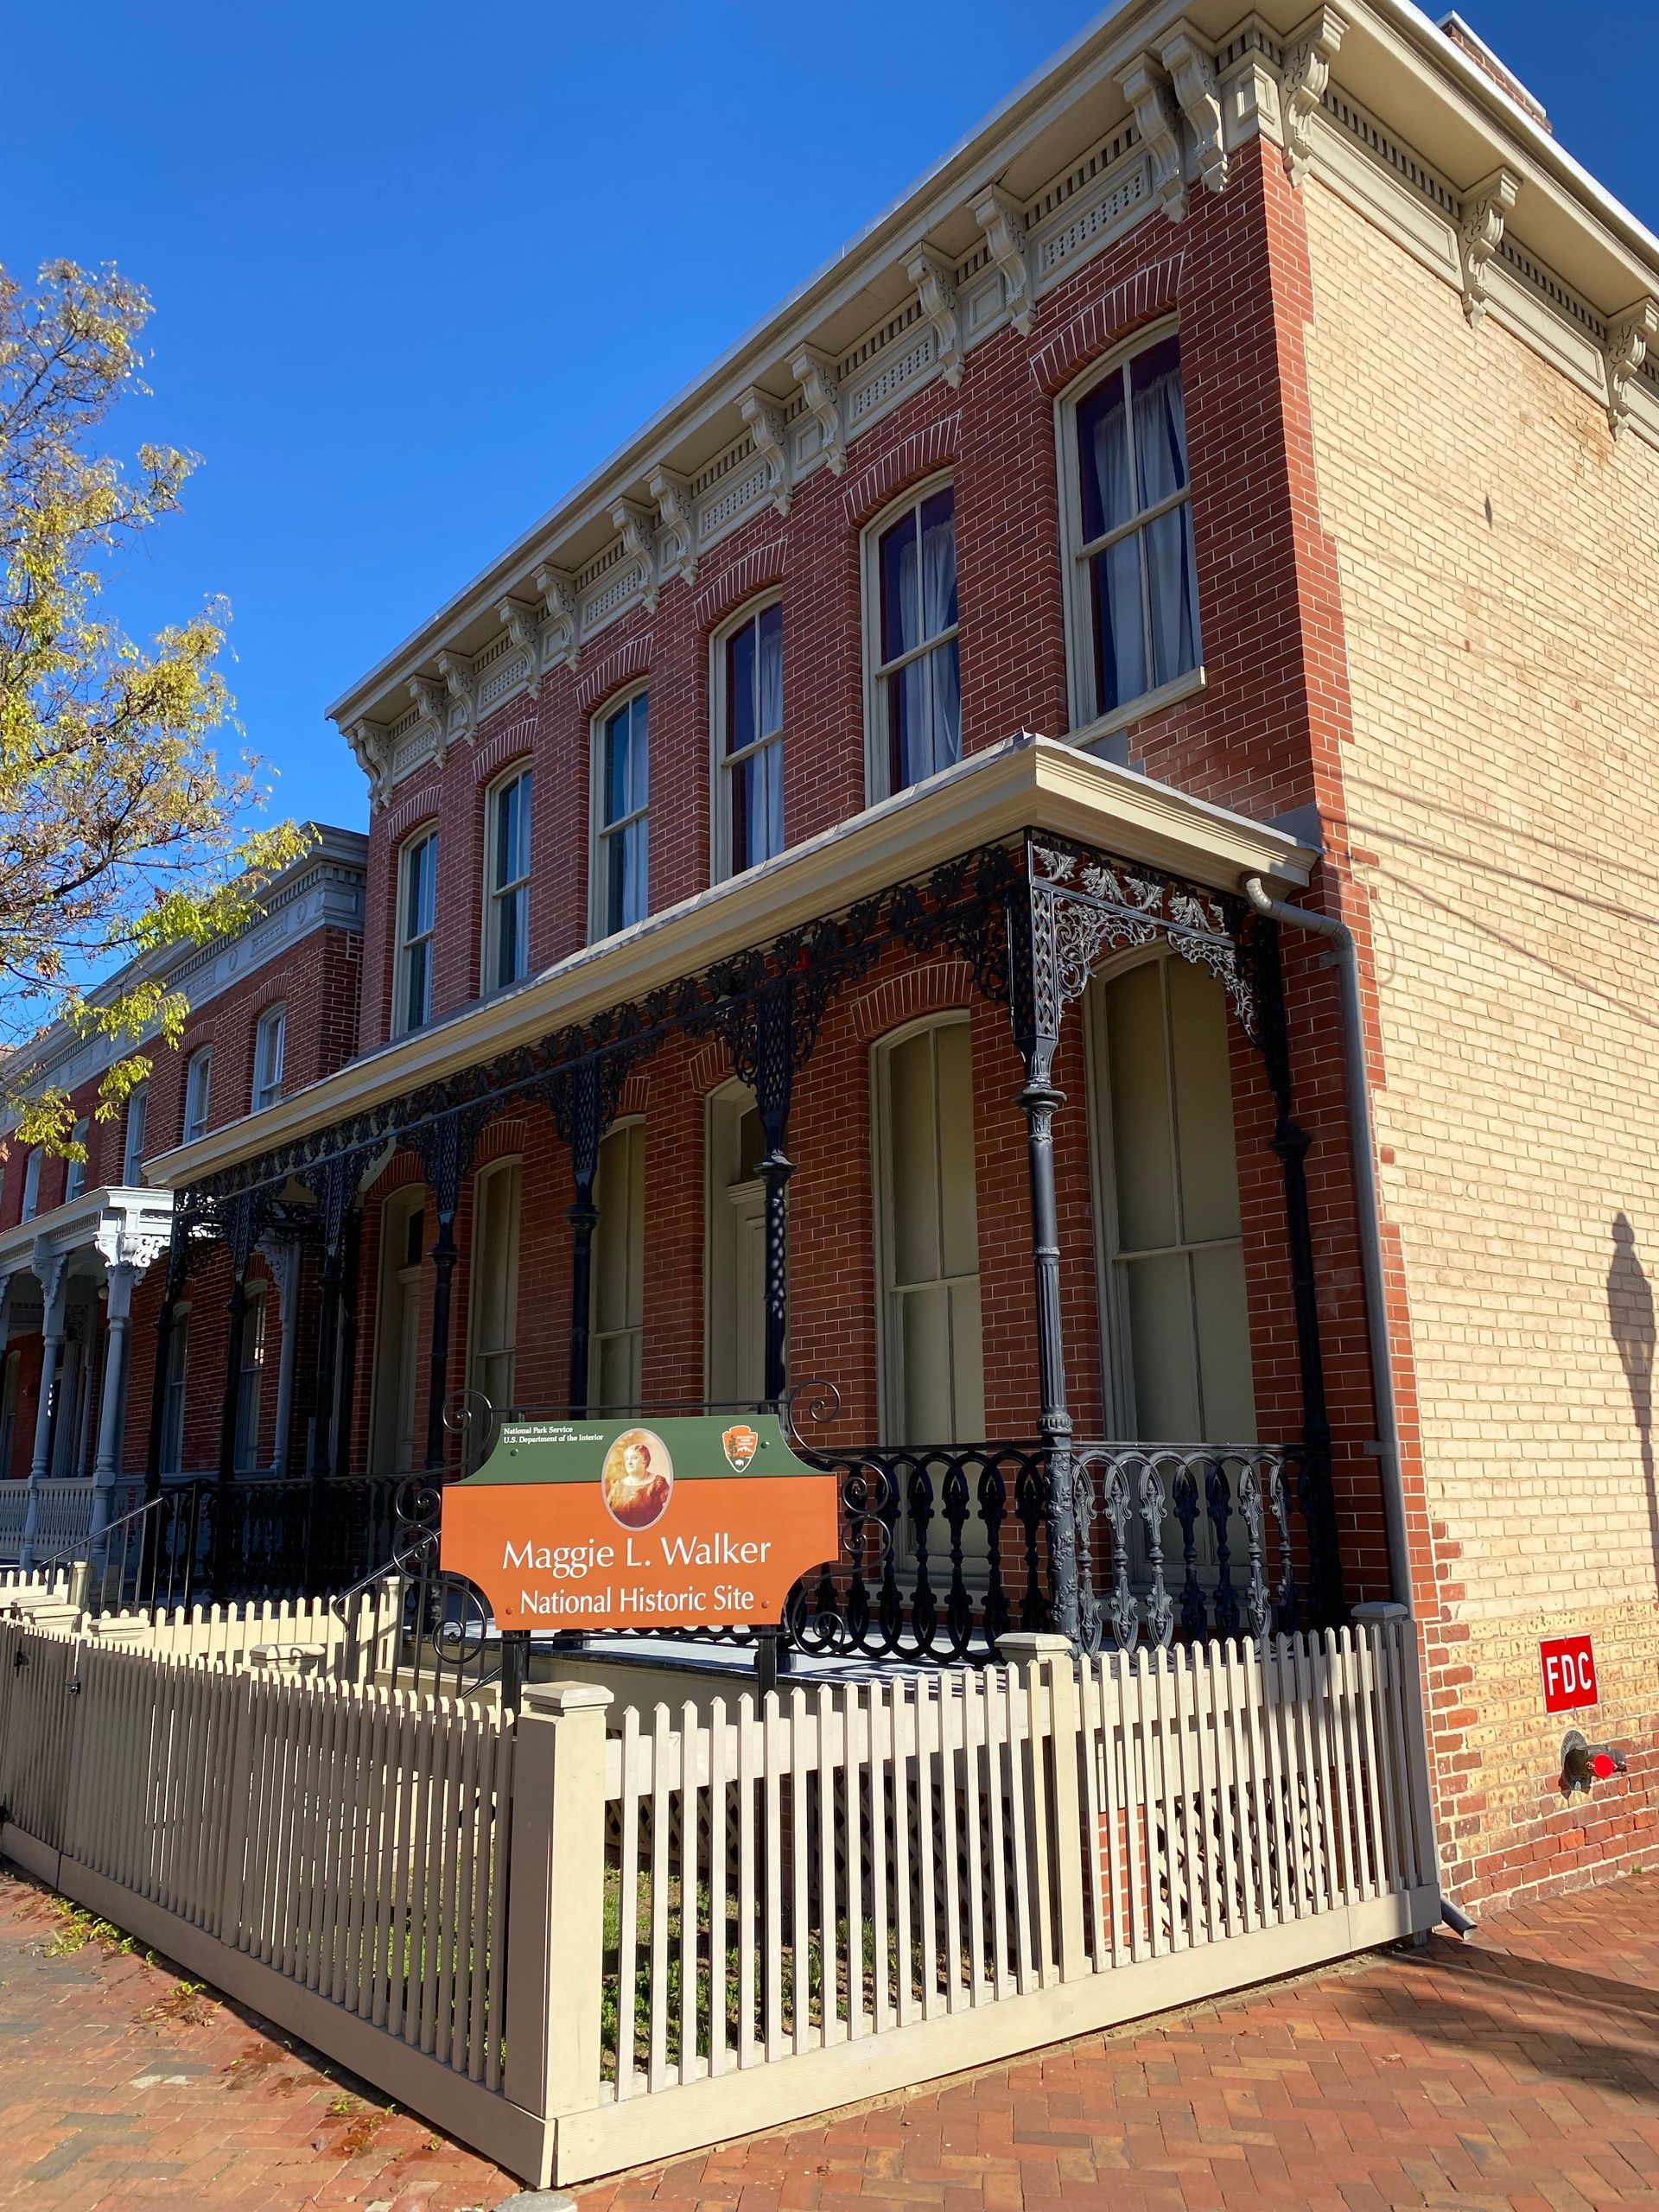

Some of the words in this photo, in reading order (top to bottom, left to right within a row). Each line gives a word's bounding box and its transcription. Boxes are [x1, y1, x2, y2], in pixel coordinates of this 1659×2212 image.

[518, 1435, 557, 1444] Department
[502, 1538, 614, 1579] Maggie
[626, 1537, 651, 1567] L.
[661, 1533, 771, 1566] Walker
[520, 1586, 612, 1614] National
[620, 1586, 706, 1613] Historic
[713, 1585, 754, 1611] Site
[1546, 1651, 1592, 1696] FDC
